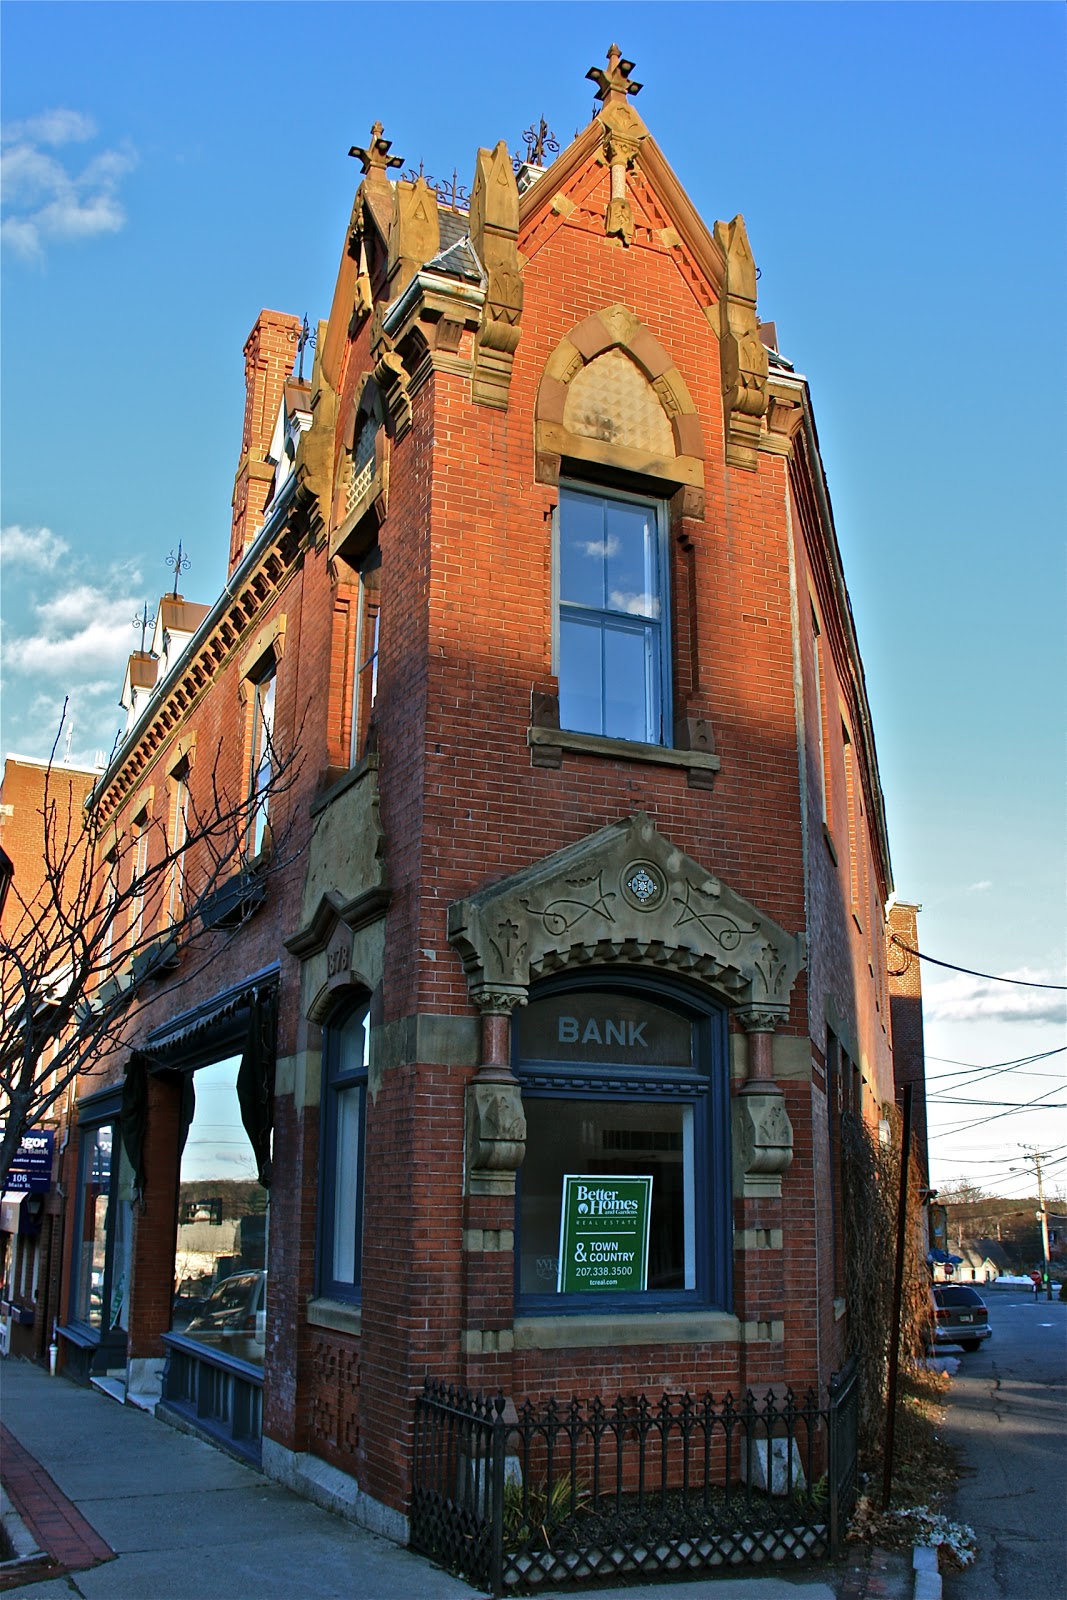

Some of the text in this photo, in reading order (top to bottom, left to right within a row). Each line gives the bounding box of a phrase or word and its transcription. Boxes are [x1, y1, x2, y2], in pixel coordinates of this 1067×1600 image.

[558, 1016, 649, 1048] BANK
[12, 1174, 28, 1182] 106
[576, 1185, 619, 1201] Better
[589, 1200, 638, 1215] Homes
[574, 1242, 587, 1263] &
[590, 1242, 619, 1251] TOWN
[589, 1252, 635, 1262] COUNTRY
[575, 1266, 633, 1277] 207.338.3500
